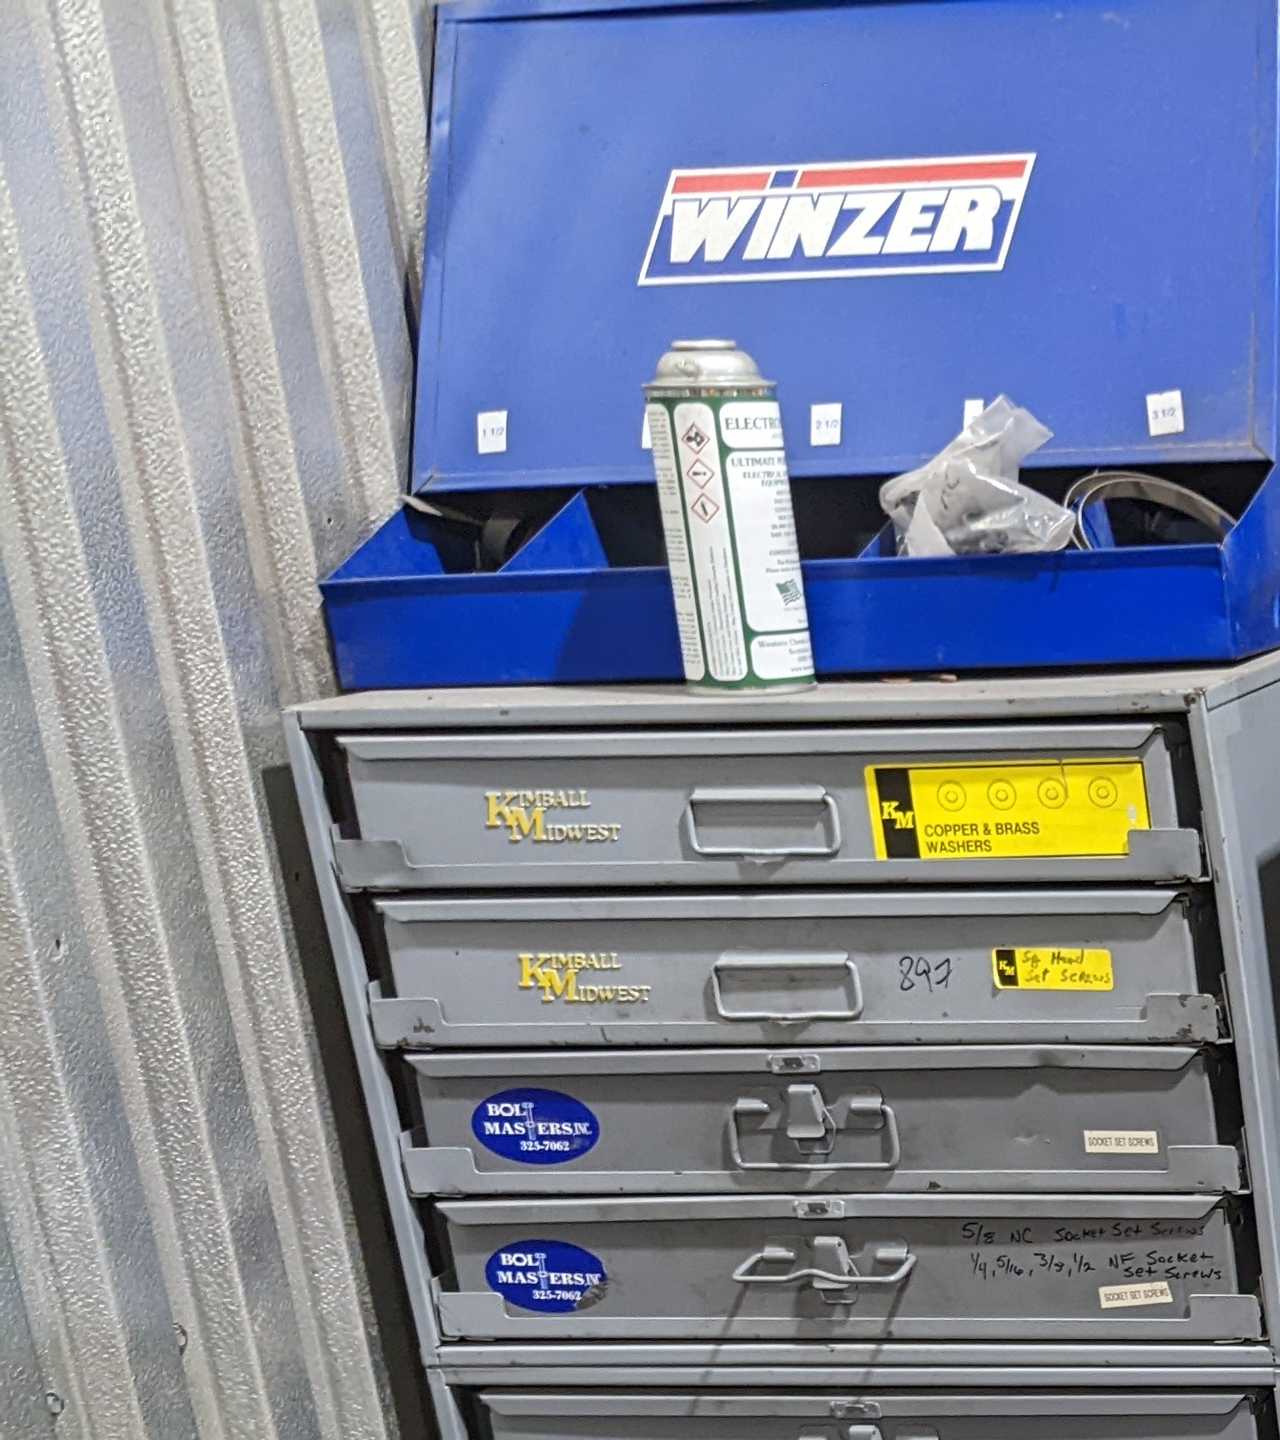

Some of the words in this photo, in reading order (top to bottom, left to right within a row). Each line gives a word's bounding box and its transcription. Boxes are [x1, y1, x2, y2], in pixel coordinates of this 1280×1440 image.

[484, 789, 591, 828] KIMBALL
[509, 807, 620, 842] MIDWEST
[924, 823, 979, 837] COPPER
[983, 823, 992, 835] &
[995, 822, 1040, 835] BRASS
[926, 839, 992, 853] WASHERS
[900, 956, 952, 992] 897
[520, 1141, 569, 1151] 325-7062
[1088, 1136, 1113, 1147] SOCKET
[1115, 1137, 1127, 1147] SET
[1129, 1137, 1155, 1147] SCREWS
[962, 1223, 993, 1245] 5/8
[1010, 1228, 1033, 1244] NC
[1113, 1223, 1142, 1236] Set
